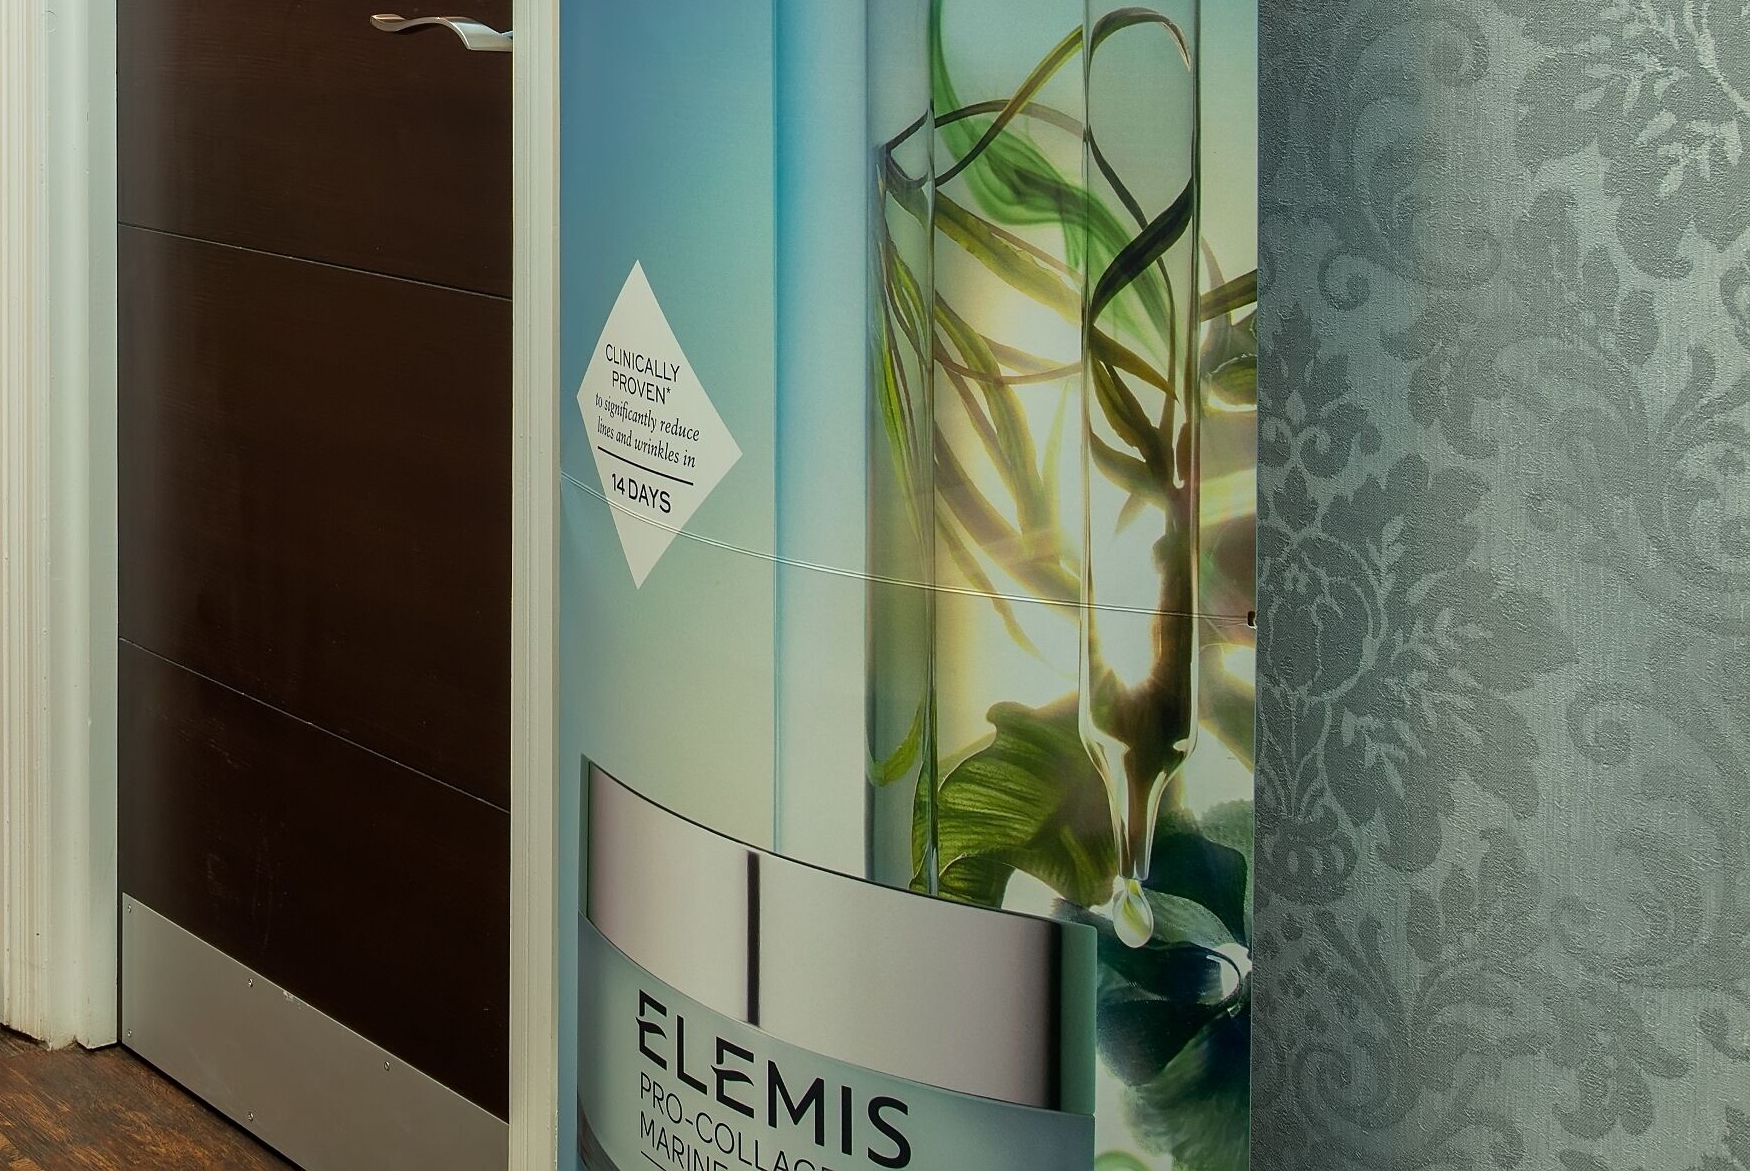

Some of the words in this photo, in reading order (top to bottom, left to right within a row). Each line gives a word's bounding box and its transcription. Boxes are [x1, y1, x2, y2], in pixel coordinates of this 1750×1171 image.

[605, 344, 680, 382] CLINICALLY
[595, 393, 603, 408] to
[605, 396, 657, 433] significantly
[660, 418, 700, 441] reduce
[597, 416, 614, 439] lines
[616, 430, 632, 447] and
[634, 438, 680, 463] wrinkles
[683, 449, 696, 468] in
[612, 473, 625, 495] 14
[628, 478, 671, 513] DAYS
[636, 989, 912, 1169] ELEMIS
[640, 1071, 835, 1171] PRO-COLLA
